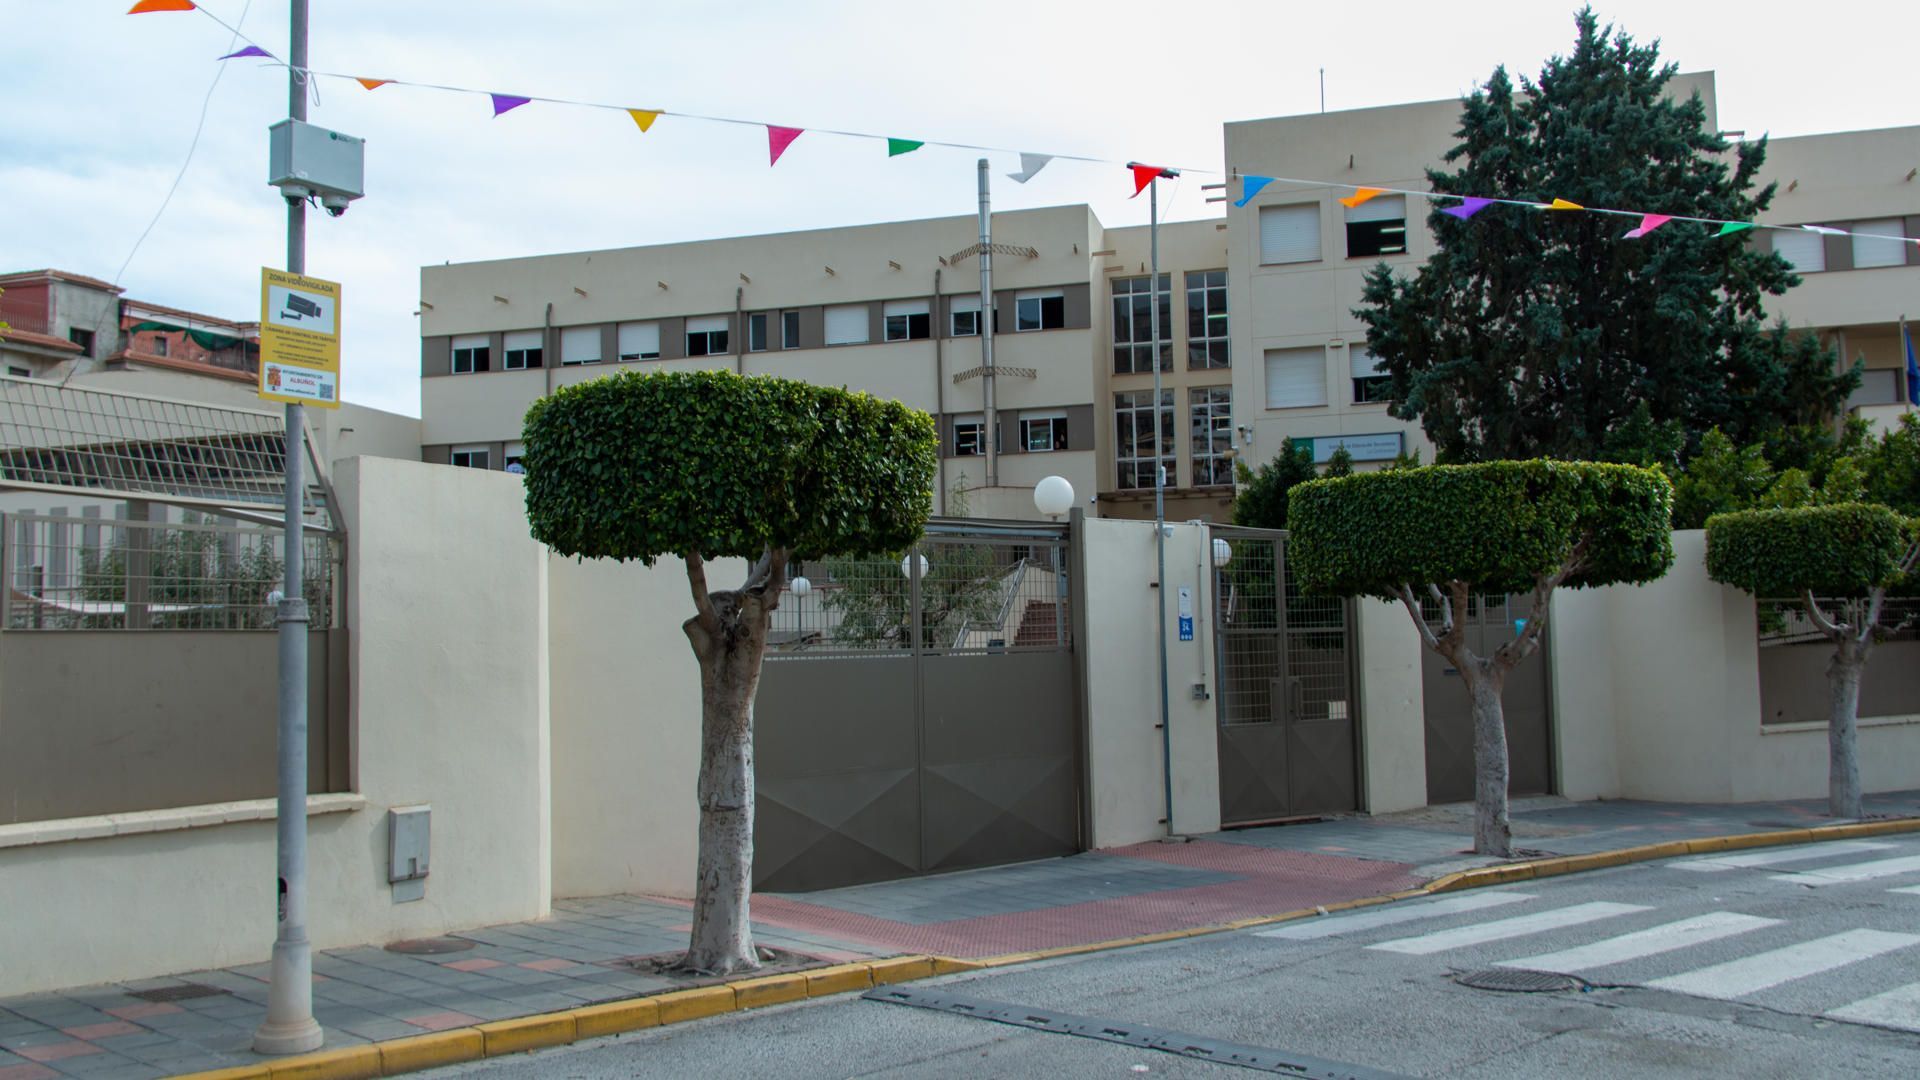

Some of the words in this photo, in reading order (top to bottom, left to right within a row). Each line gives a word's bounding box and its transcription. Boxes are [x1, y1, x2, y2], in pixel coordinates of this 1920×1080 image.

[269, 272, 286, 282] ZONA
[287, 277, 334, 292] VIDEOVIGILADA
[290, 376, 316, 386] ALBUÑOL
